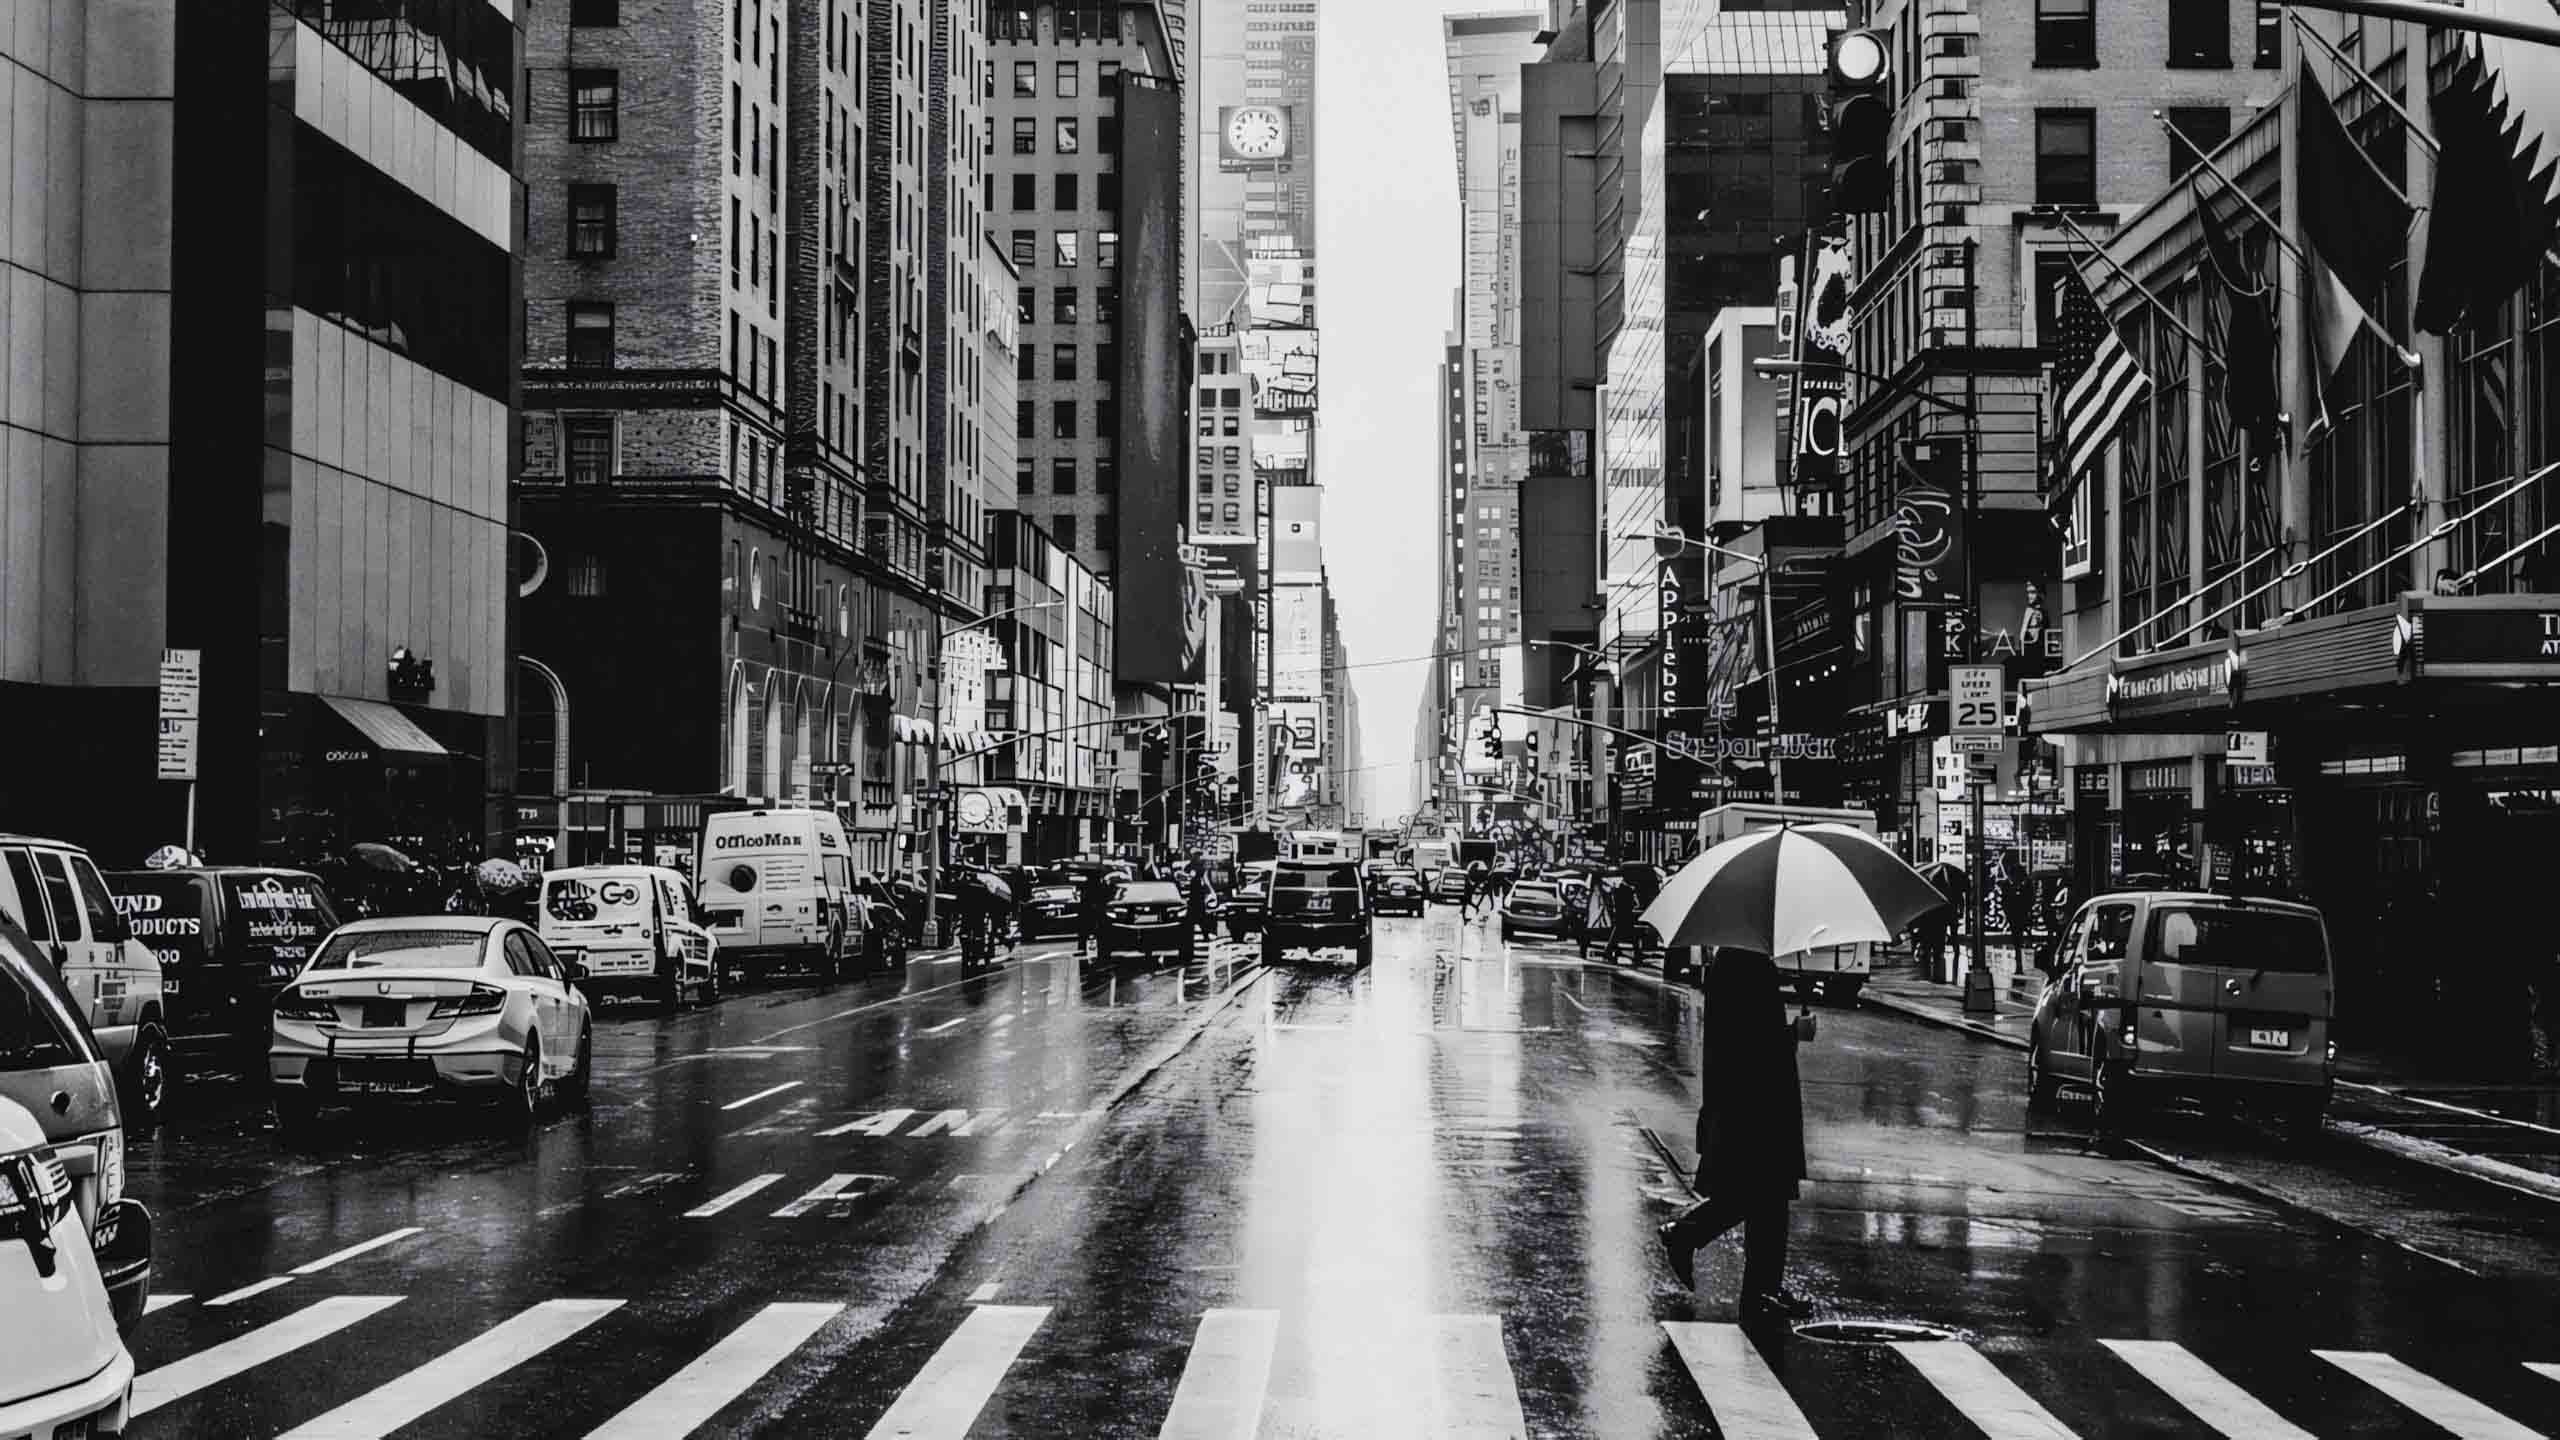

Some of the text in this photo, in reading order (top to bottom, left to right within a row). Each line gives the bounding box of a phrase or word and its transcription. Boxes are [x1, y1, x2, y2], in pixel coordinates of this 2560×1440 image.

[1991, 628, 2063, 657] APE
[1958, 703, 1997, 726] 25
[130, 918, 200, 935] ODUCTS
